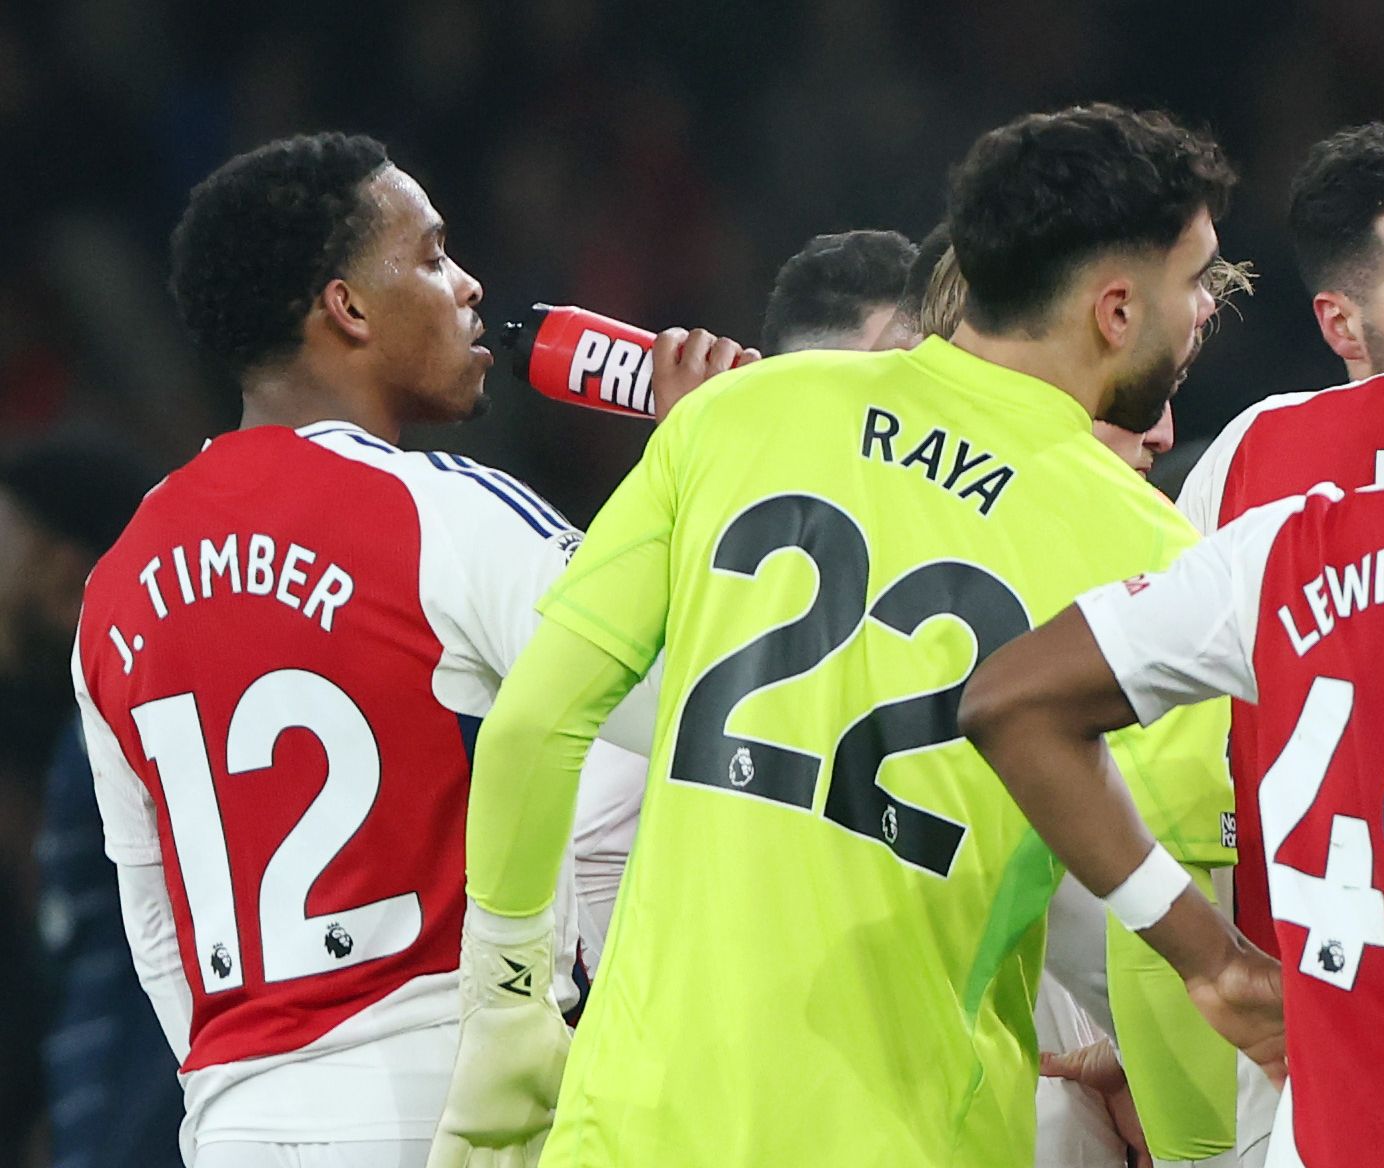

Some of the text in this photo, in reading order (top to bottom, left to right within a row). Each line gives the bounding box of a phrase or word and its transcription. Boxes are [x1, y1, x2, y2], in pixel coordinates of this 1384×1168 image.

[568, 328, 656, 416] PRI
[859, 405, 1016, 518] RAYA
[109, 533, 354, 676] J. TIMBER
[668, 491, 1033, 878] 22
[130, 667, 423, 995] 12
